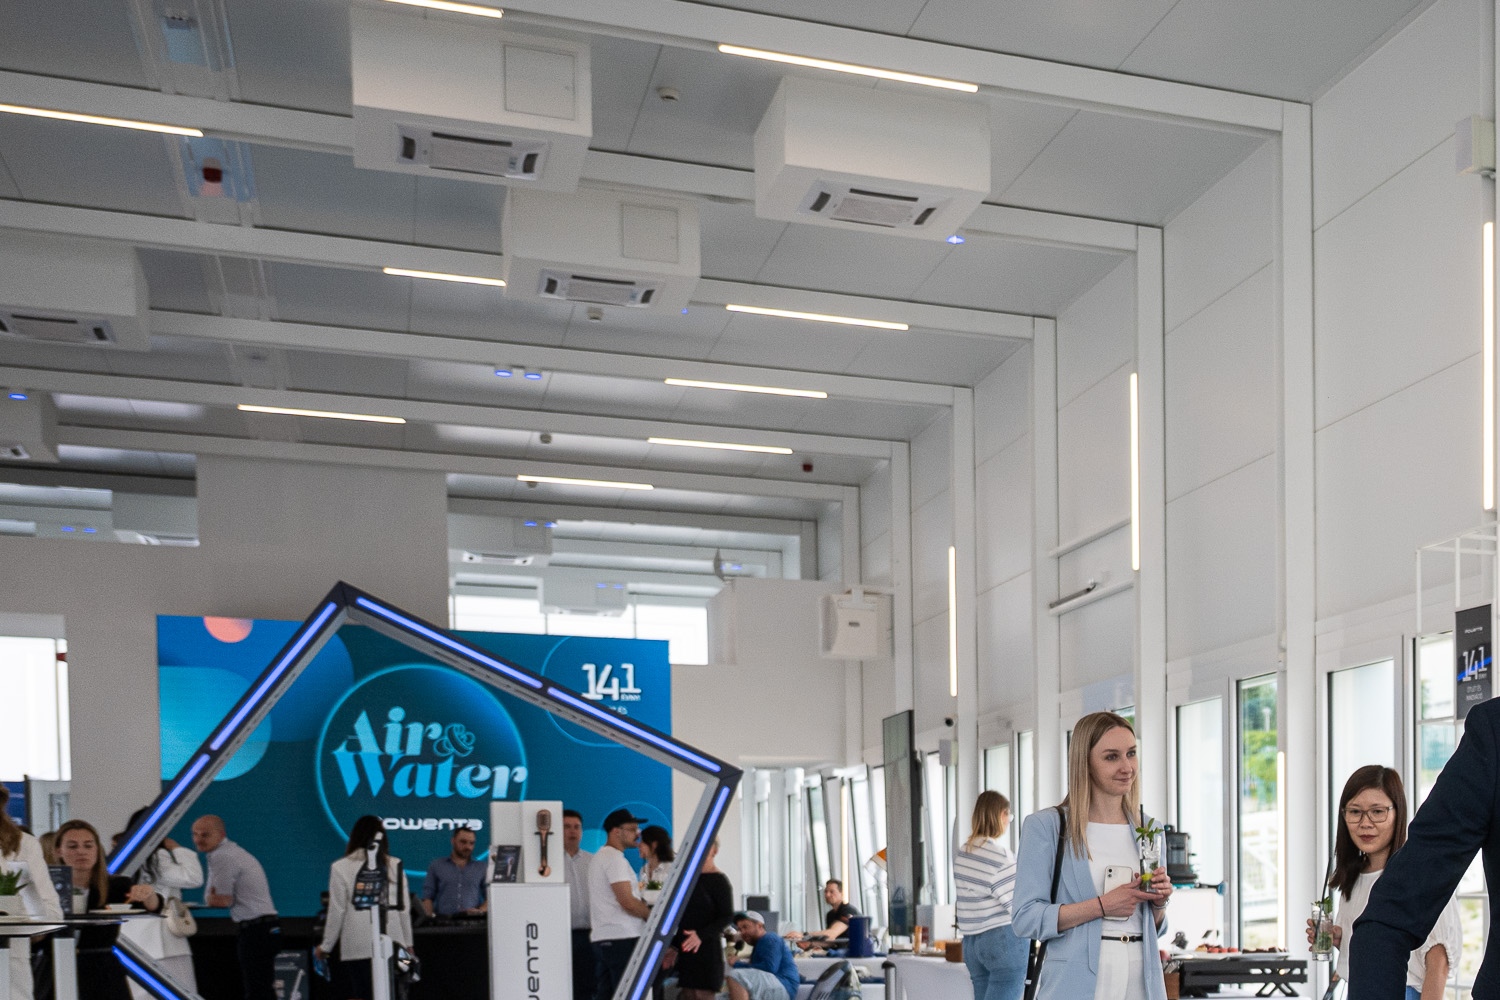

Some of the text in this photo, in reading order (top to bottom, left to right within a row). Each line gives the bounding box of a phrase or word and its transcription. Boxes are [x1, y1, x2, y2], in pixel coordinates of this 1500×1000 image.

[581, 663, 642, 701] 141
[1462, 646, 1488, 682] 141
[337, 706, 443, 757] Air
[333, 751, 528, 799] Water
[379, 817, 484, 831] owenta
